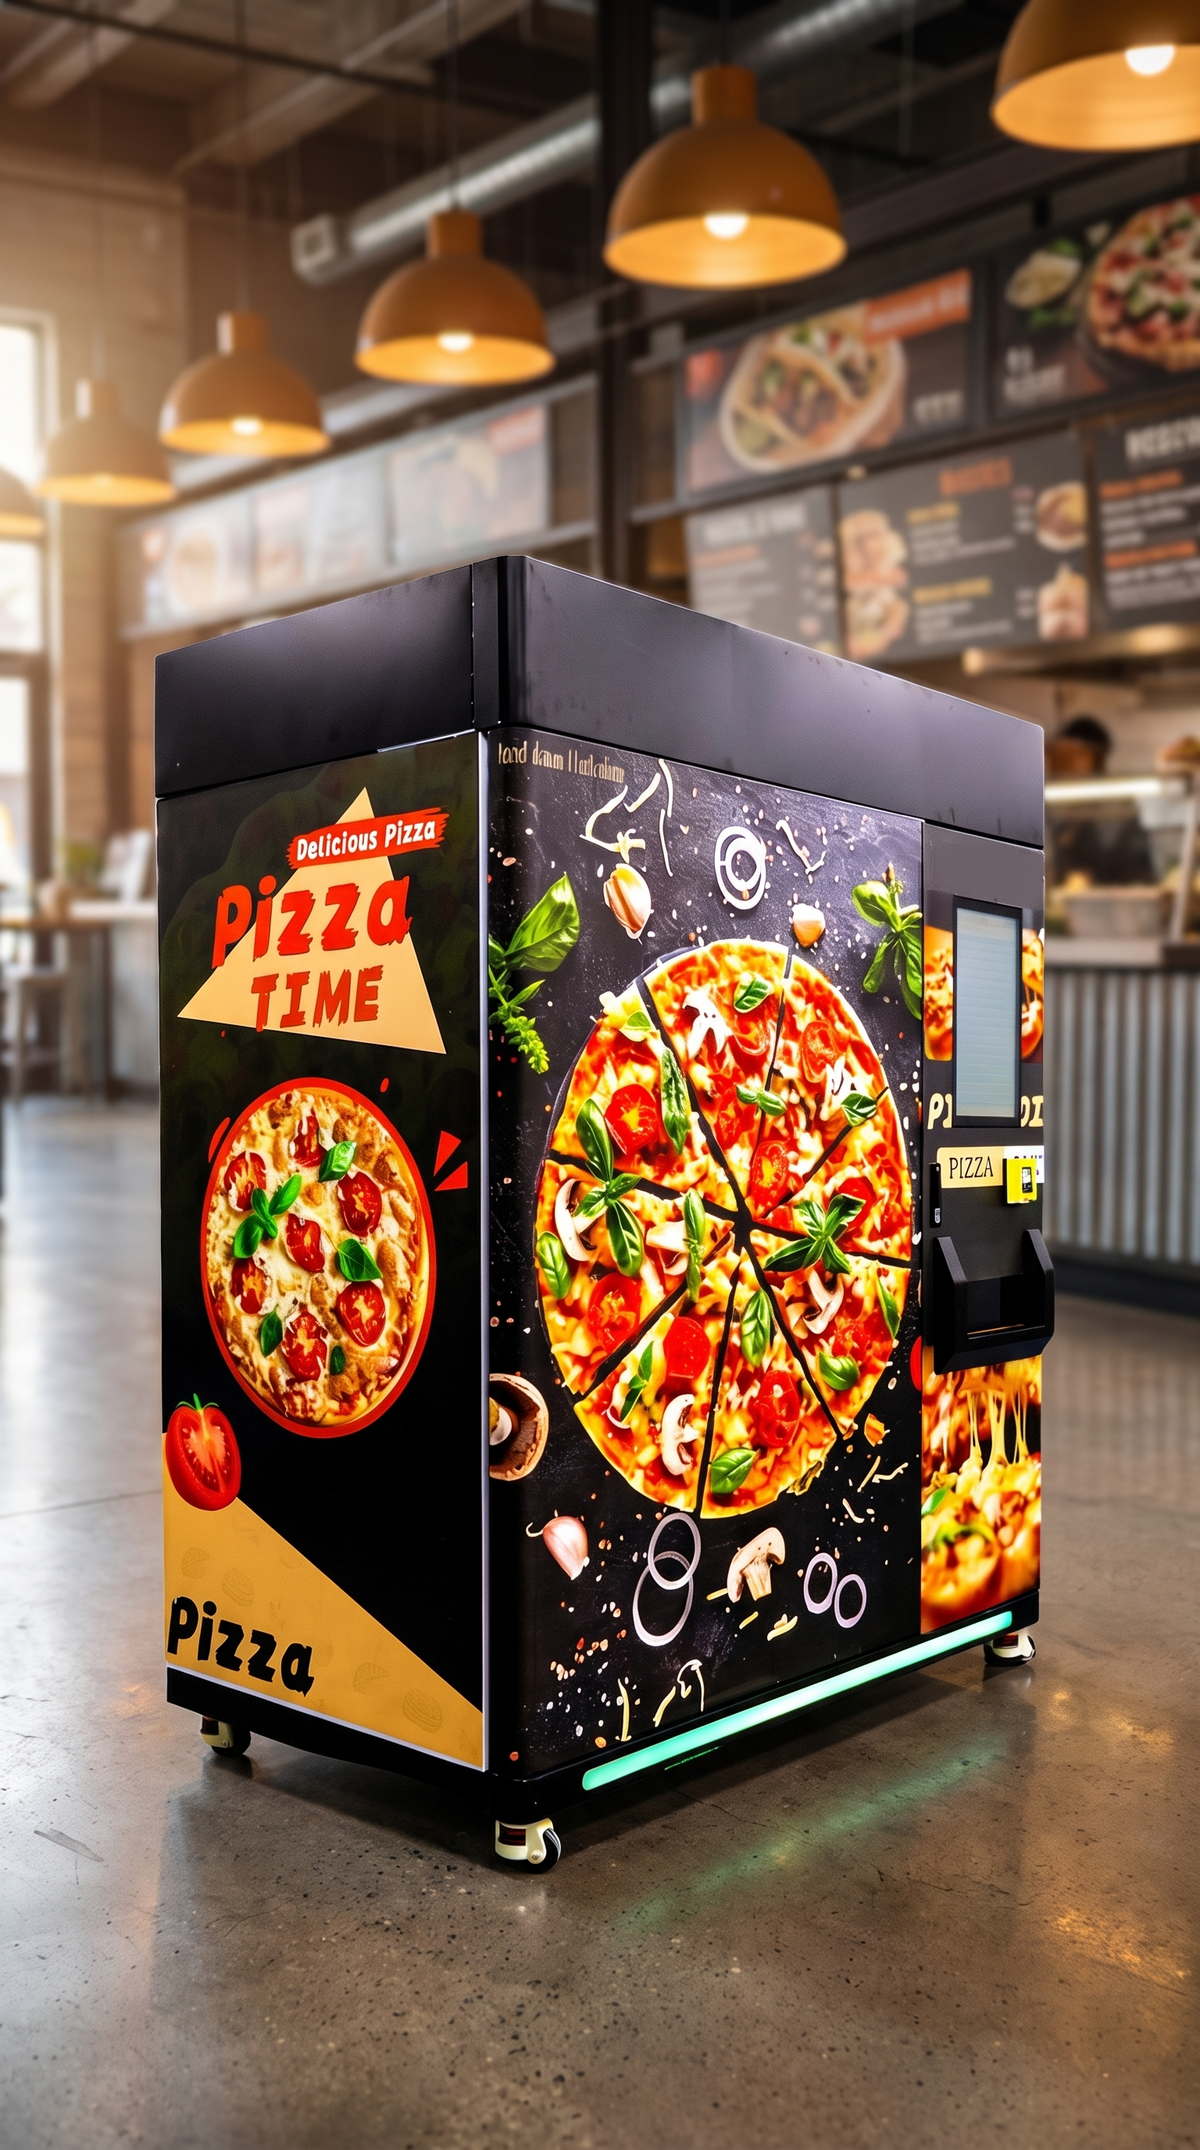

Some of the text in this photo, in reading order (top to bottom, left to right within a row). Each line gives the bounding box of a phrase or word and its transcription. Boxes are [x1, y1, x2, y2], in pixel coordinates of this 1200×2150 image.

[297, 820, 436, 861] Delicious Pizza
[211, 875, 413, 970] Pizza
[251, 965, 384, 1033] TIME
[949, 1156, 994, 1180] PIZZA
[167, 1596, 315, 1697] Pizza
